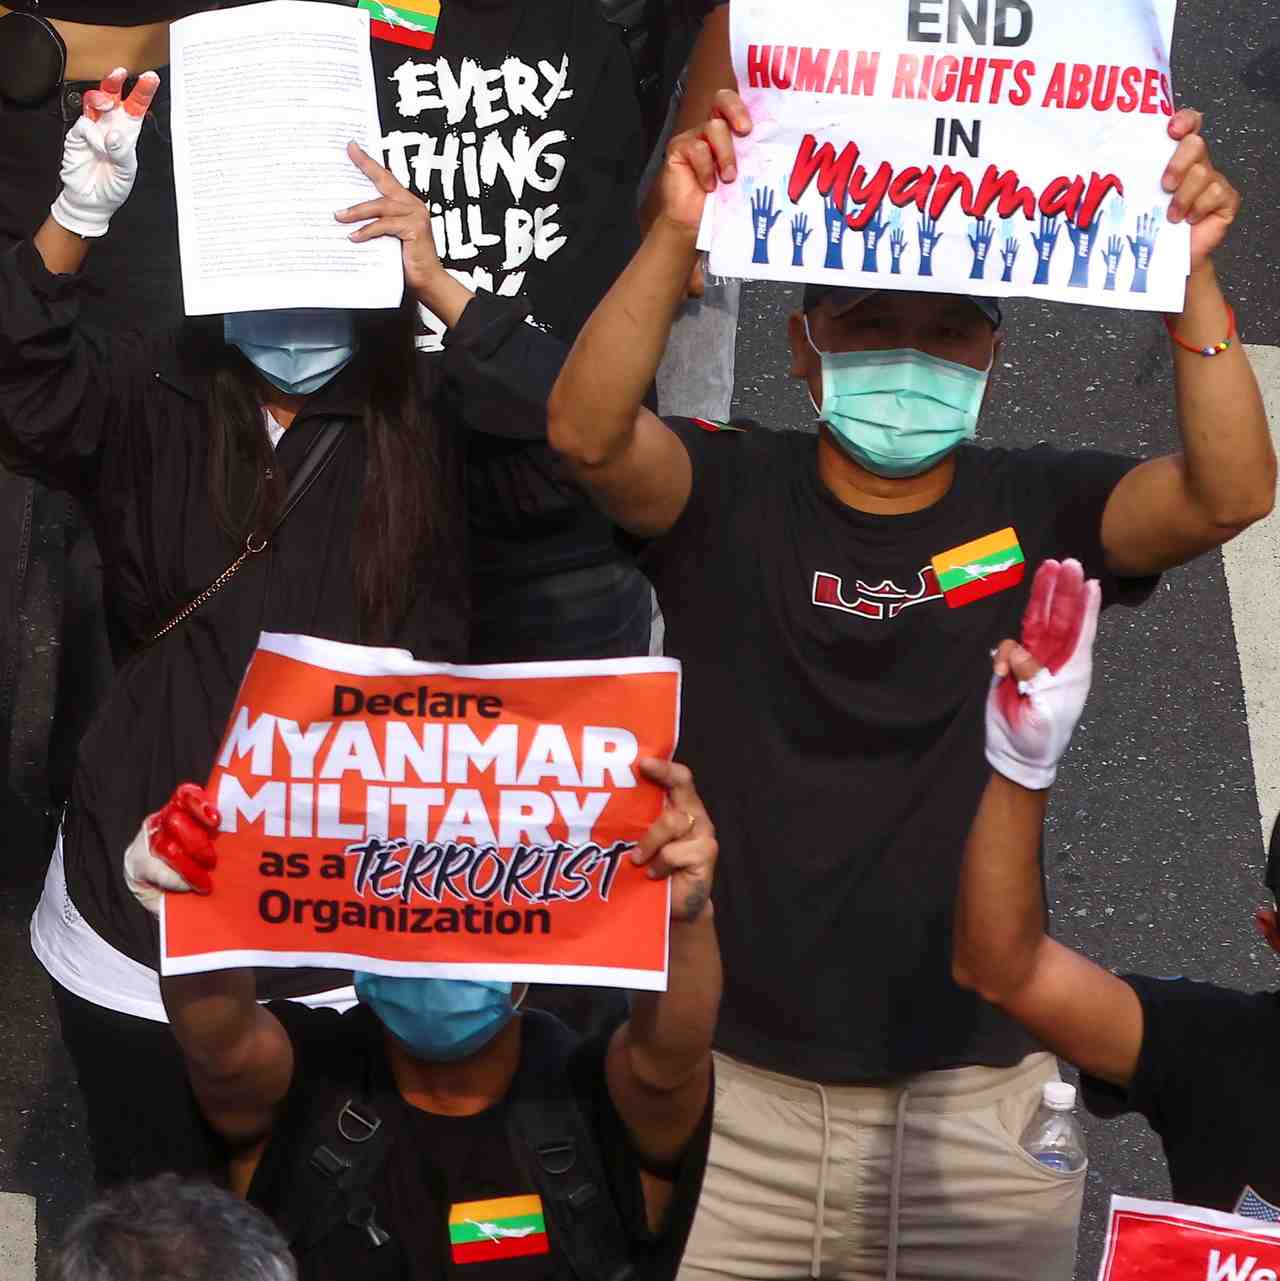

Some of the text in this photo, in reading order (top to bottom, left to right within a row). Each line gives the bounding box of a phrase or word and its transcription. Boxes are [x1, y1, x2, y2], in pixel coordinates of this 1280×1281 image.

[747, 45, 1174, 117] HUMAN RIGHTS ABUSES
[932, 117, 981, 157] IN
[787, 133, 1124, 231] Myanmar
[504, 204, 568, 270] BE
[332, 685, 503, 719] Declare
[218, 705, 639, 788] MYANMAR
[216, 774, 612, 848] MILITARY
[259, 837, 640, 904] as a TERRORIST
[258, 890, 550, 935] Organization
